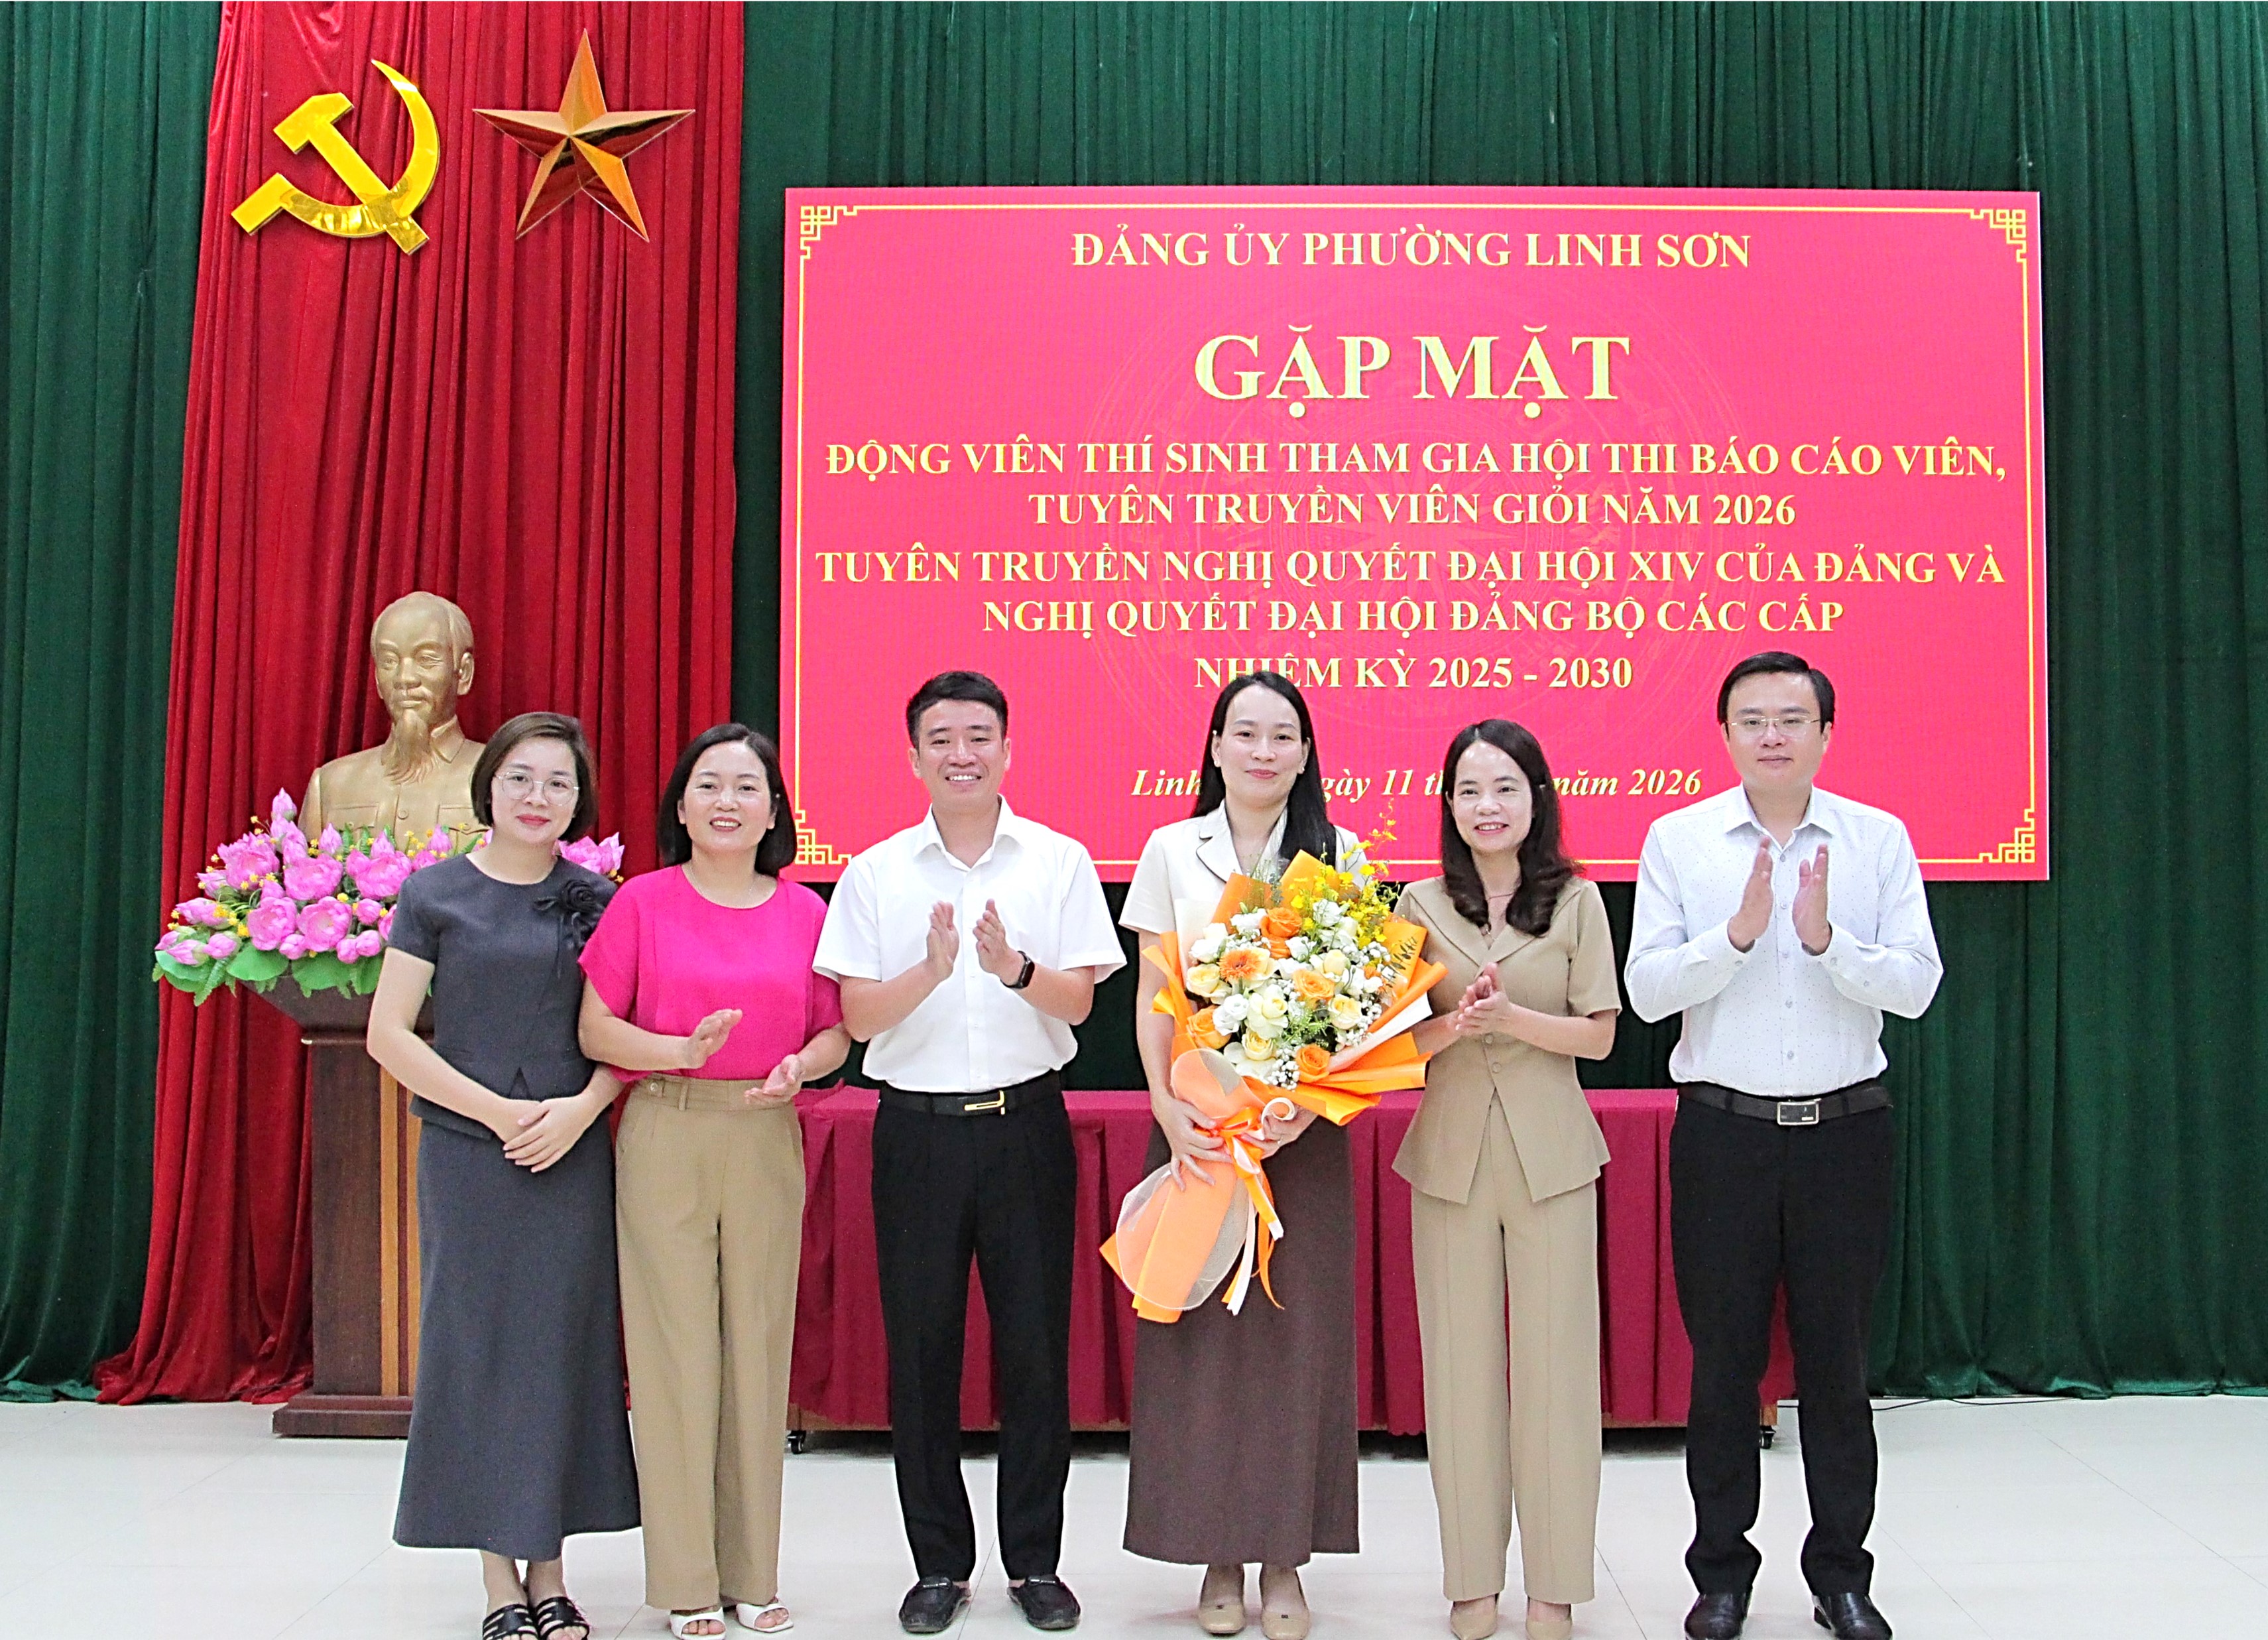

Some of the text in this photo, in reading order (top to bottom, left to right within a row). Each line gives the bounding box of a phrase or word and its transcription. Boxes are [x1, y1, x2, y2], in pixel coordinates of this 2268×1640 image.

[1072, 223, 1751, 269] ĐẢNG ỦY PHƯỜNG LINH SƠN
[1195, 324, 1630, 418] GẶP MẶT
[826, 434, 2006, 482] ĐỘNG VIÊN THÍ SINH THAM GIA HỘI THI BÁO CÁO VIÊN,
[1029, 483, 1796, 526] TUYÊN TRUYỀN VIÊN GIỎI NĂM 2026
[815, 542, 2005, 590] TUYÊN TRUYỀN NGHỊ QUYẾT ĐẠI HỘI XIV CỦA ĐẢNG VÀ
[983, 592, 1844, 639] NGHỊ QUYẾT ĐẠI HỘI ĐẢNG BỘ CÁC CẤP
[1356, 649, 1417, 688] KỲ
[1429, 658, 1512, 689] 2025
[1549, 658, 1633, 689] 2030
[1131, 769, 1201, 796] Linh
[1321, 769, 1371, 803] gày
[1381, 770, 1414, 795] 11
[1553, 770, 1618, 796] năm
[1628, 769, 1702, 796] 2026
